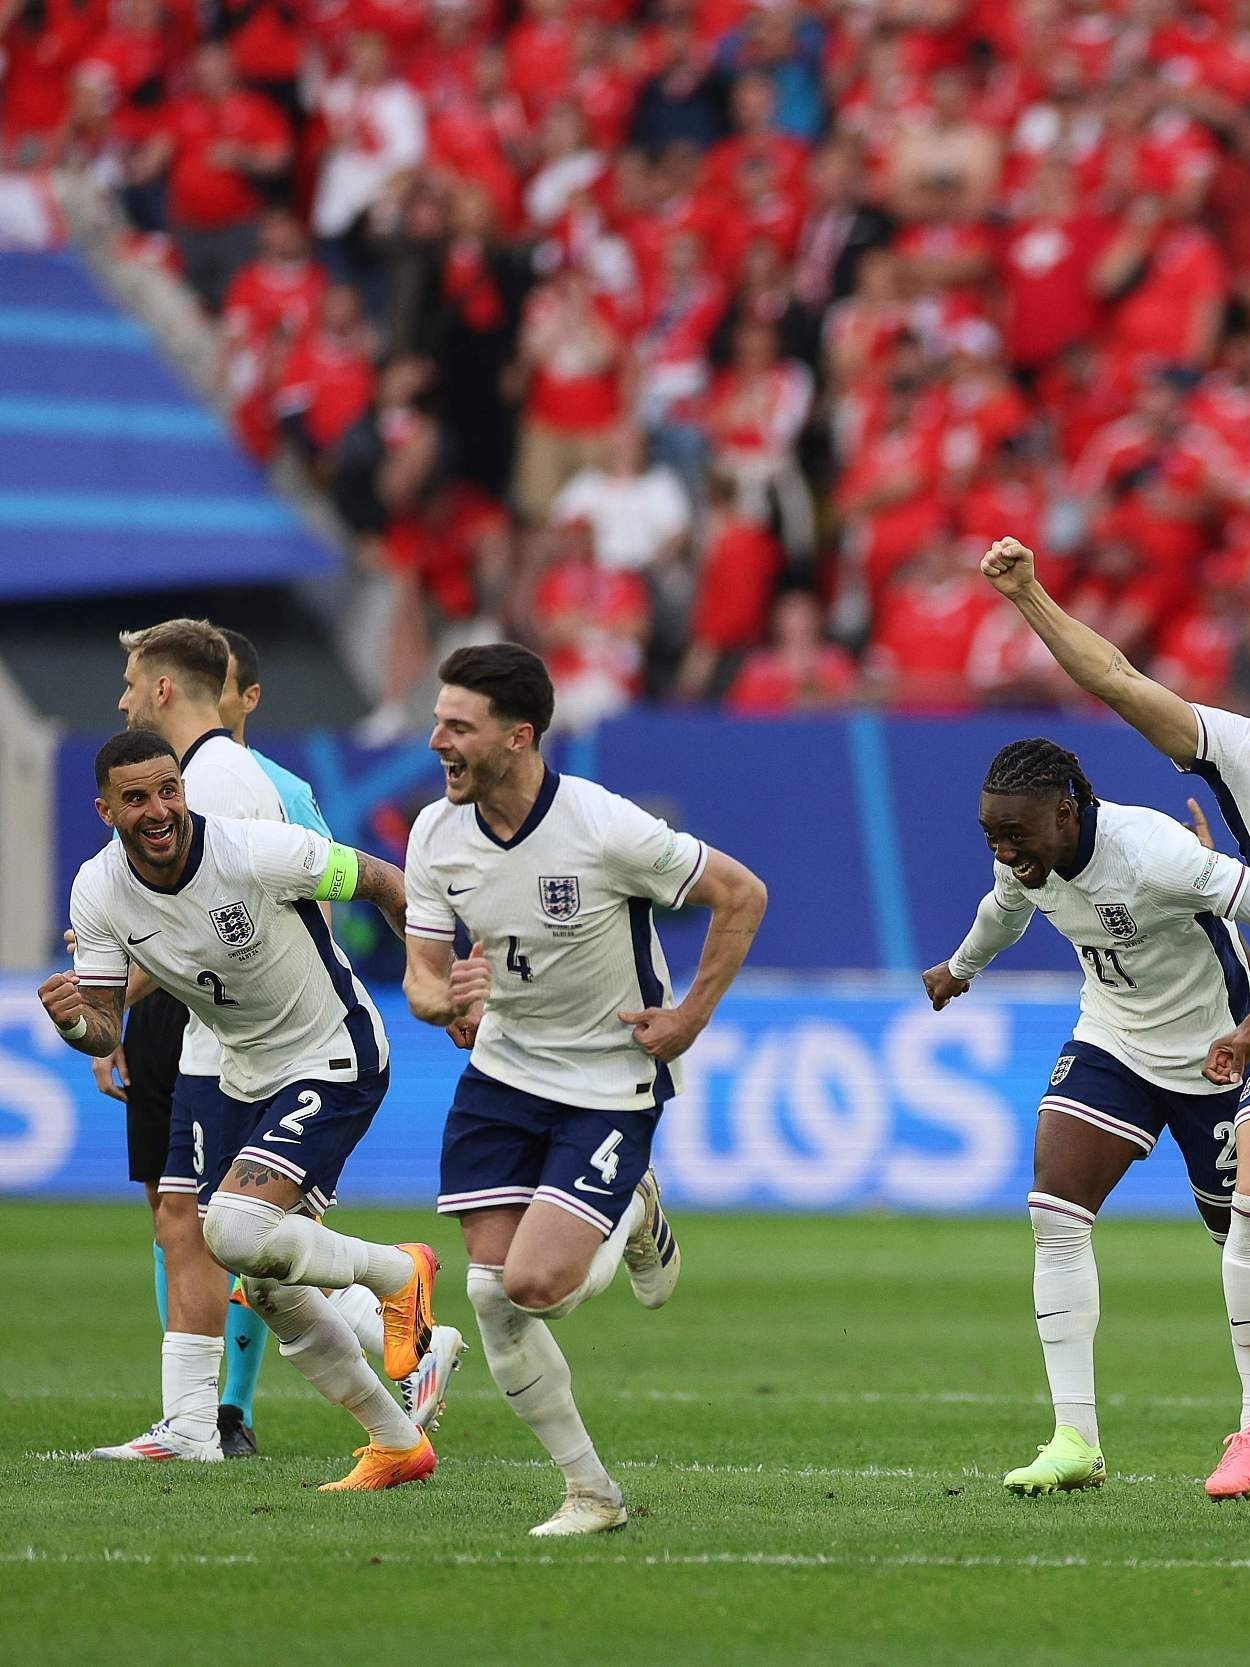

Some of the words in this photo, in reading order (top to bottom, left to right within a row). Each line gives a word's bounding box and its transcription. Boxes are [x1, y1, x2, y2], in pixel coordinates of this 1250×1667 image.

[329, 868, 344, 900] ESPECT
[507, 935, 534, 983] 4
[1082, 945, 1138, 989] 21
[196, 970, 241, 1007] 2
[279, 1089, 322, 1136] 2
[192, 1120, 205, 1176] 3
[589, 1128, 624, 1185] 4
[1213, 1121, 1238, 1170] 2
